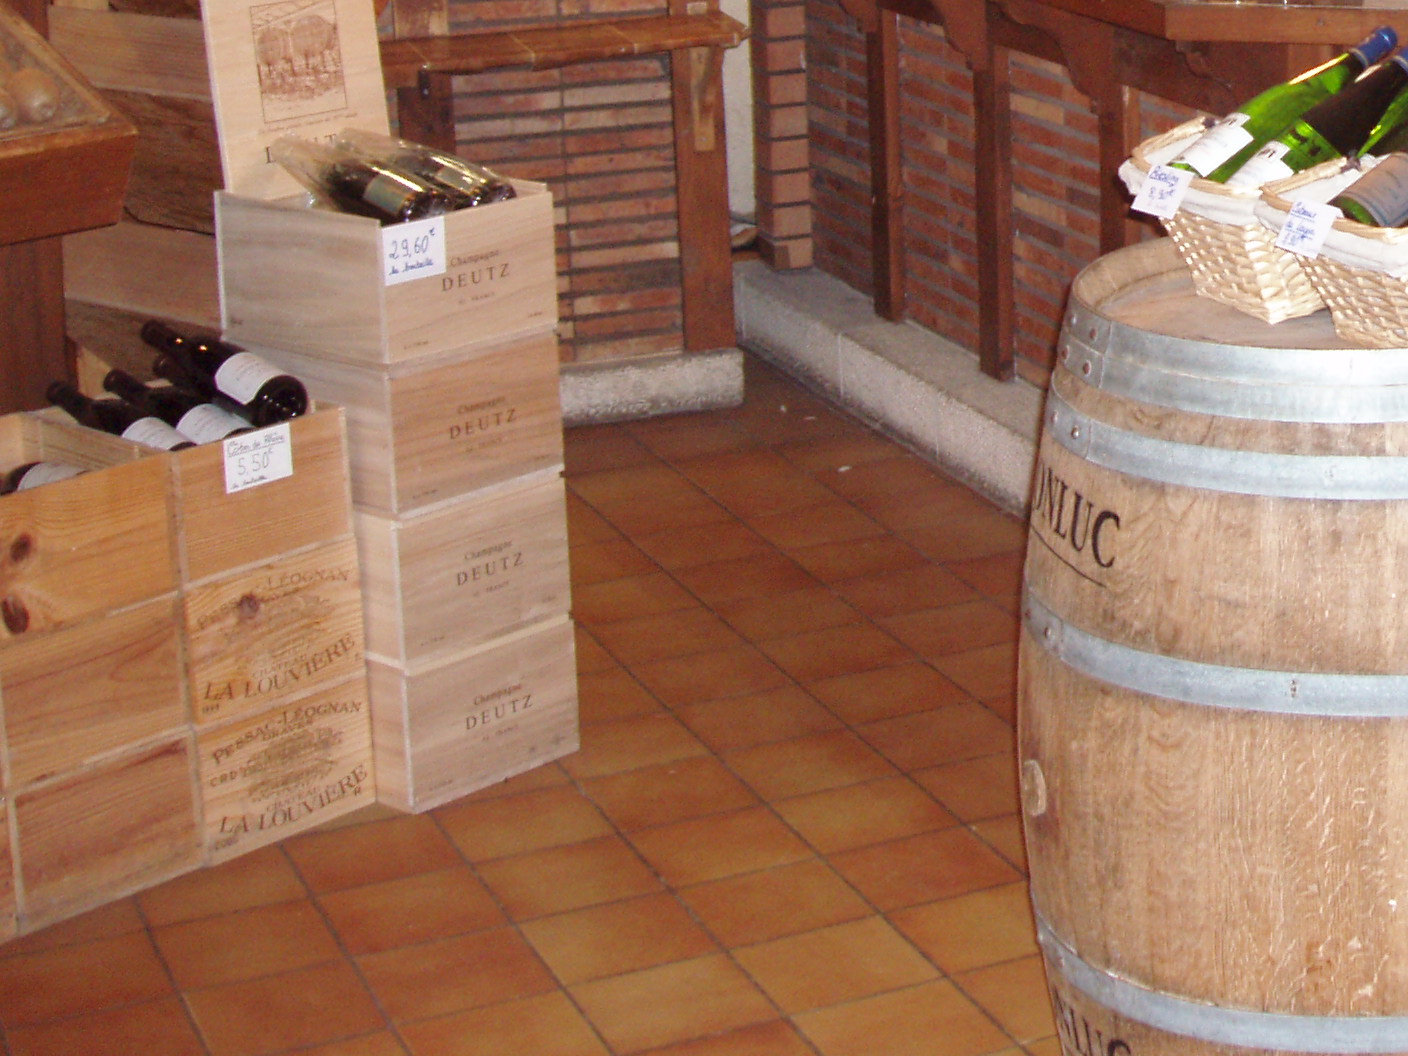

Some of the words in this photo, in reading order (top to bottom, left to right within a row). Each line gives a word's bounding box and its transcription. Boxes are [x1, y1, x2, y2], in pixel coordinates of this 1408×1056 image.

[451, 250, 500, 268] Champagne
[442, 263, 510, 292] DEUTZ
[450, 408, 518, 440] DEUTZ
[457, 552, 524, 587] DEUTZ
[202, 681, 237, 701] LA
[466, 694, 534, 731] DEUTZ
[220, 816, 250, 834] LA
